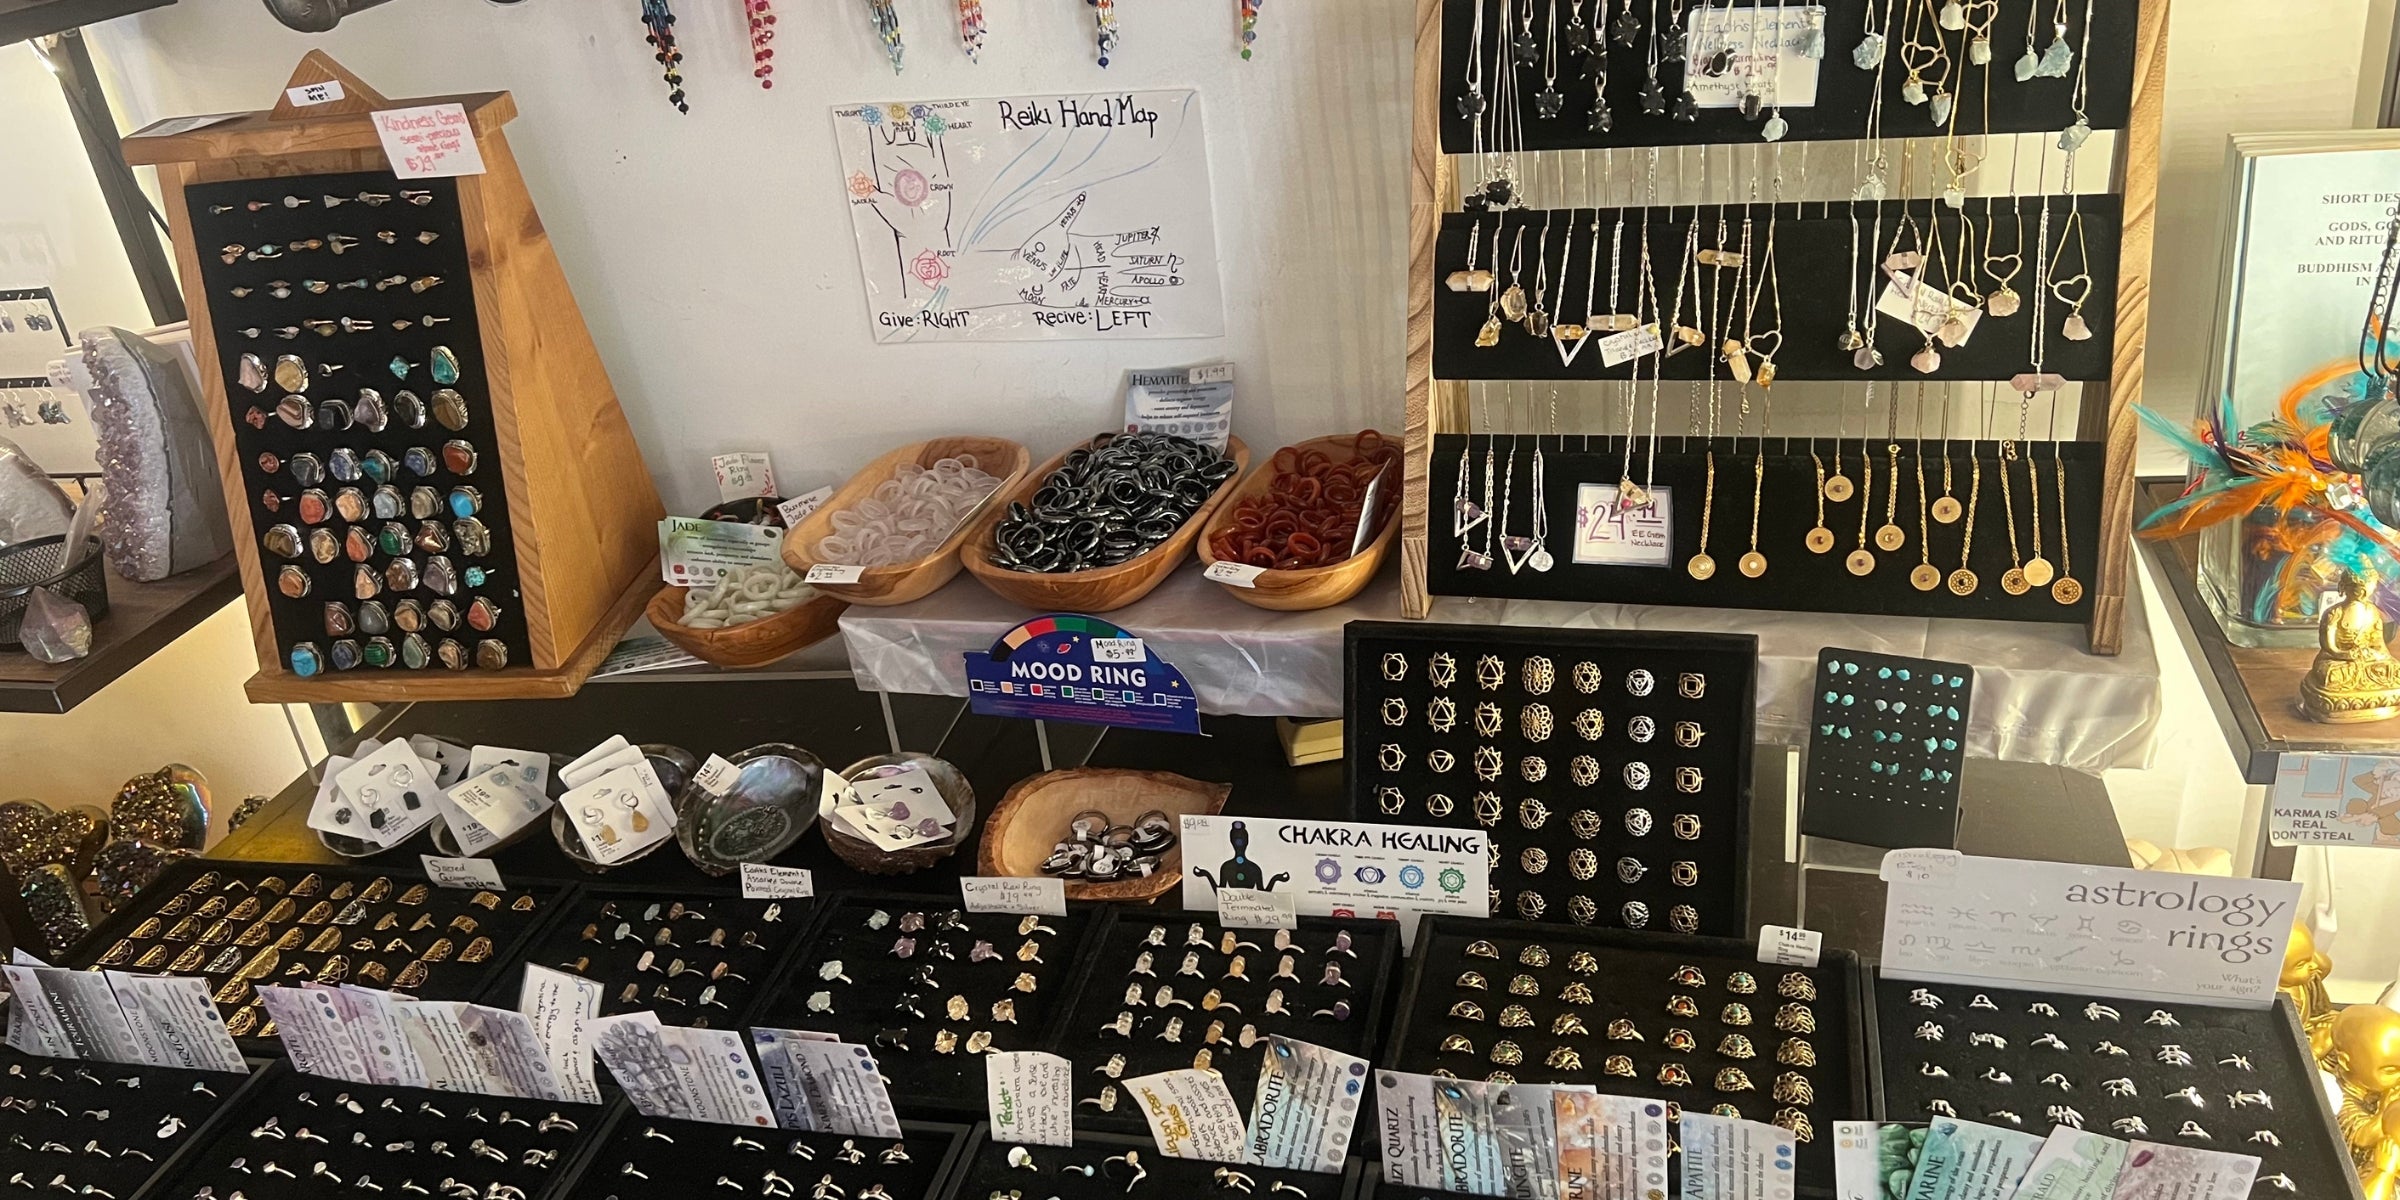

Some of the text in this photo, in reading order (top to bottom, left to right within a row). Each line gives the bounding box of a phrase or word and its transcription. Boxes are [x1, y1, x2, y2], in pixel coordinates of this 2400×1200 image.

[380, 110, 466, 132] Kindness Gems
[998, 95, 1158, 138] Reiki Hand Map
[948, 121, 973, 130] HEART
[930, 183, 954, 191] CROWN
[2322, 194, 2369, 204] SHORT
[2329, 222, 2371, 232] GODS,
[1114, 231, 1150, 246] JUPITER
[2315, 236, 2344, 246] AND
[937, 250, 956, 258] ROOT
[1092, 241, 1106, 263] HEAD
[1021, 249, 1048, 271] VENUS
[1129, 255, 1163, 265] SATURN
[2297, 263, 2372, 273] BUDDHISM
[1131, 274, 1165, 284] APOLLO
[2356, 276, 2370, 286] IN
[1019, 288, 1046, 305] MOON
[1095, 295, 1133, 307] MERCURY
[718, 456, 740, 469] Jade
[729, 466, 751, 476] Ring
[672, 519, 702, 532] JADE
[1647, 530, 1666, 538] Gem
[1631, 540, 1664, 548] Necklace
[1011, 661, 1147, 688] MOOD RING
[2274, 808, 2338, 819] KARMA IS
[2293, 820, 2327, 829] REAL
[1278, 825, 1481, 855] CHAKRA HEALING
[2272, 831, 2355, 841] DON'T STEAL
[429, 860, 466, 872] Sacred
[770, 868, 804, 877] Elements
[965, 882, 998, 893] Crystal
[1023, 881, 1042, 895] Ring
[1220, 890, 1255, 901] Double
[1221, 902, 1275, 912] Terminated
[2065, 880, 2288, 928] astrology
[1222, 911, 1249, 925] Ring
[2167, 925, 2274, 964] rings
[2221, 972, 2262, 986] What's
[2195, 983, 2262, 995] your sign?
[546, 1008, 560, 1039] energy
[130, 1010, 159, 1063] MOONSTONE
[680, 1066, 708, 1118] MOONSTONE
[770, 1066, 794, 1110] LAZULI
[997, 1087, 1015, 1127] Peridot
[1167, 1104, 1188, 1137] Glass
[1253, 1070, 1285, 1167] LABRADORITE
[1386, 1107, 1405, 1158] QUARTZ
[1685, 1148, 1702, 1199] APATITE
